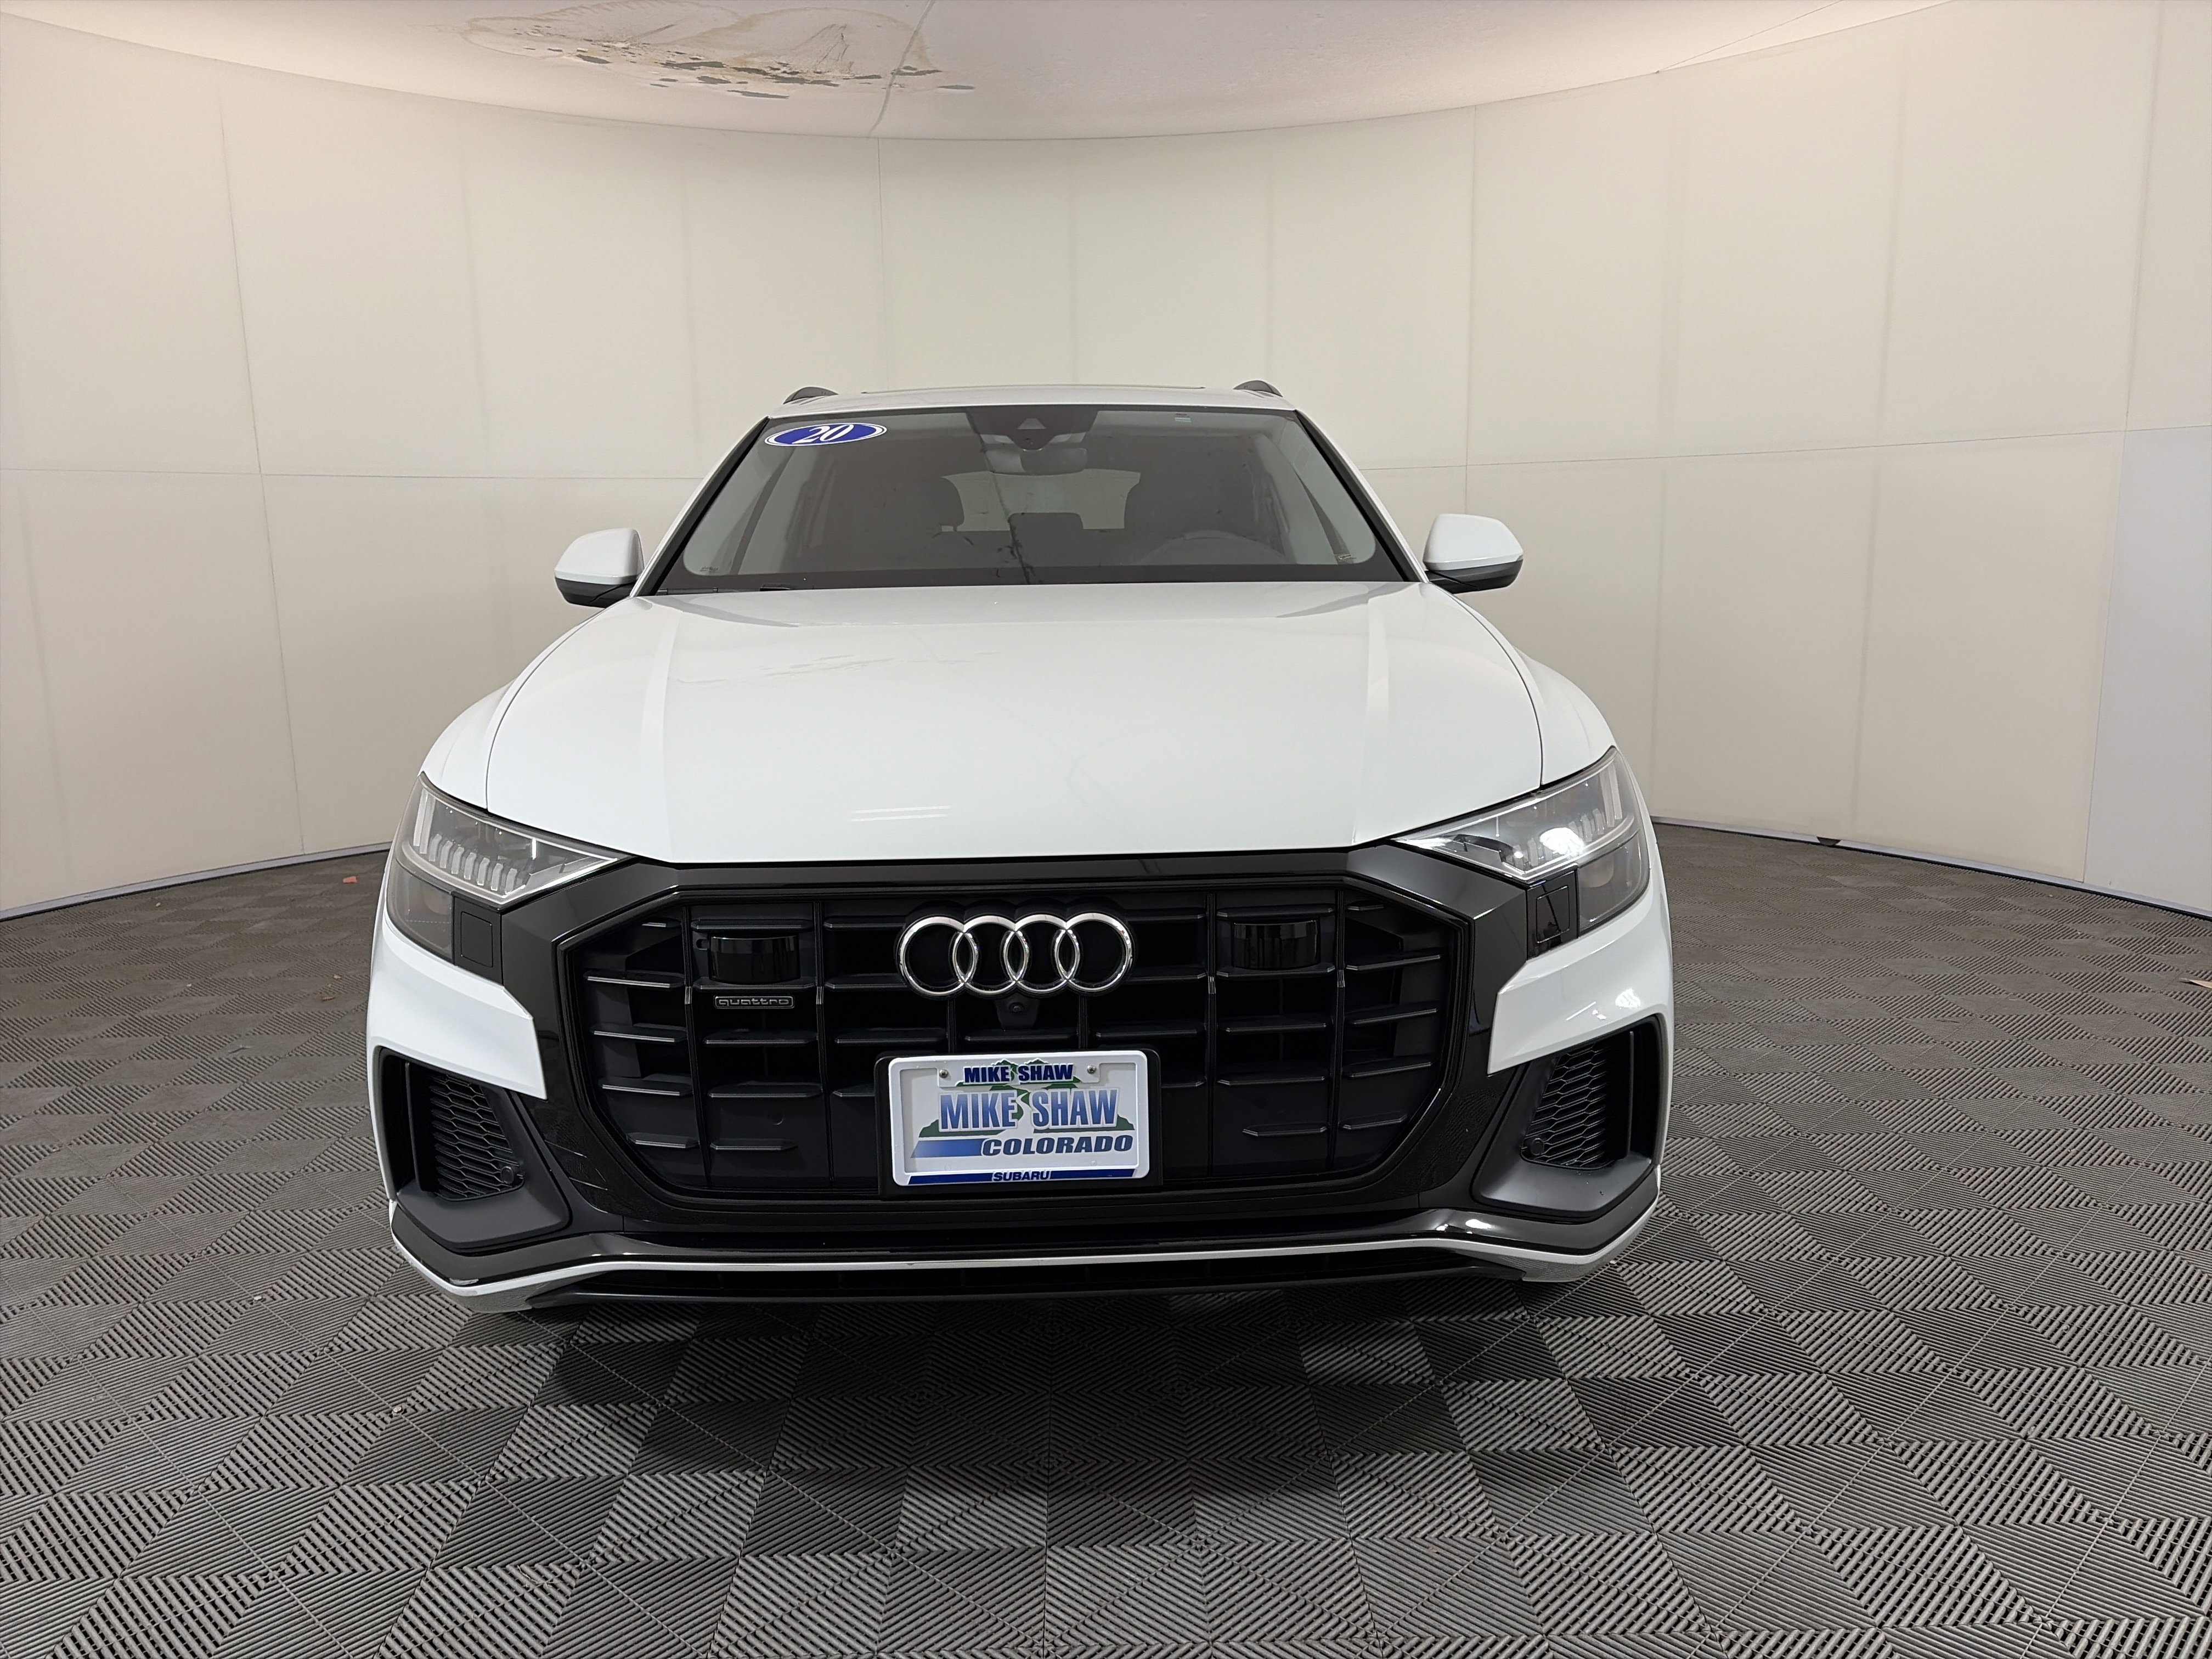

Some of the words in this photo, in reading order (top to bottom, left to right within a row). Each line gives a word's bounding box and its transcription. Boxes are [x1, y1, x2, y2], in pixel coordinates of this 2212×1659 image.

[792, 424, 854, 444] 20
[719, 998, 789, 1007] quattro
[964, 1066, 1010, 1083] MIKE
[1018, 1064, 1073, 1081] SHAW
[940, 1092, 1018, 1130] MIKE
[1032, 1088, 1118, 1128] SHAW
[983, 1135, 1133, 1156] COLORADO
[994, 1171, 1051, 1181] SUBARU
